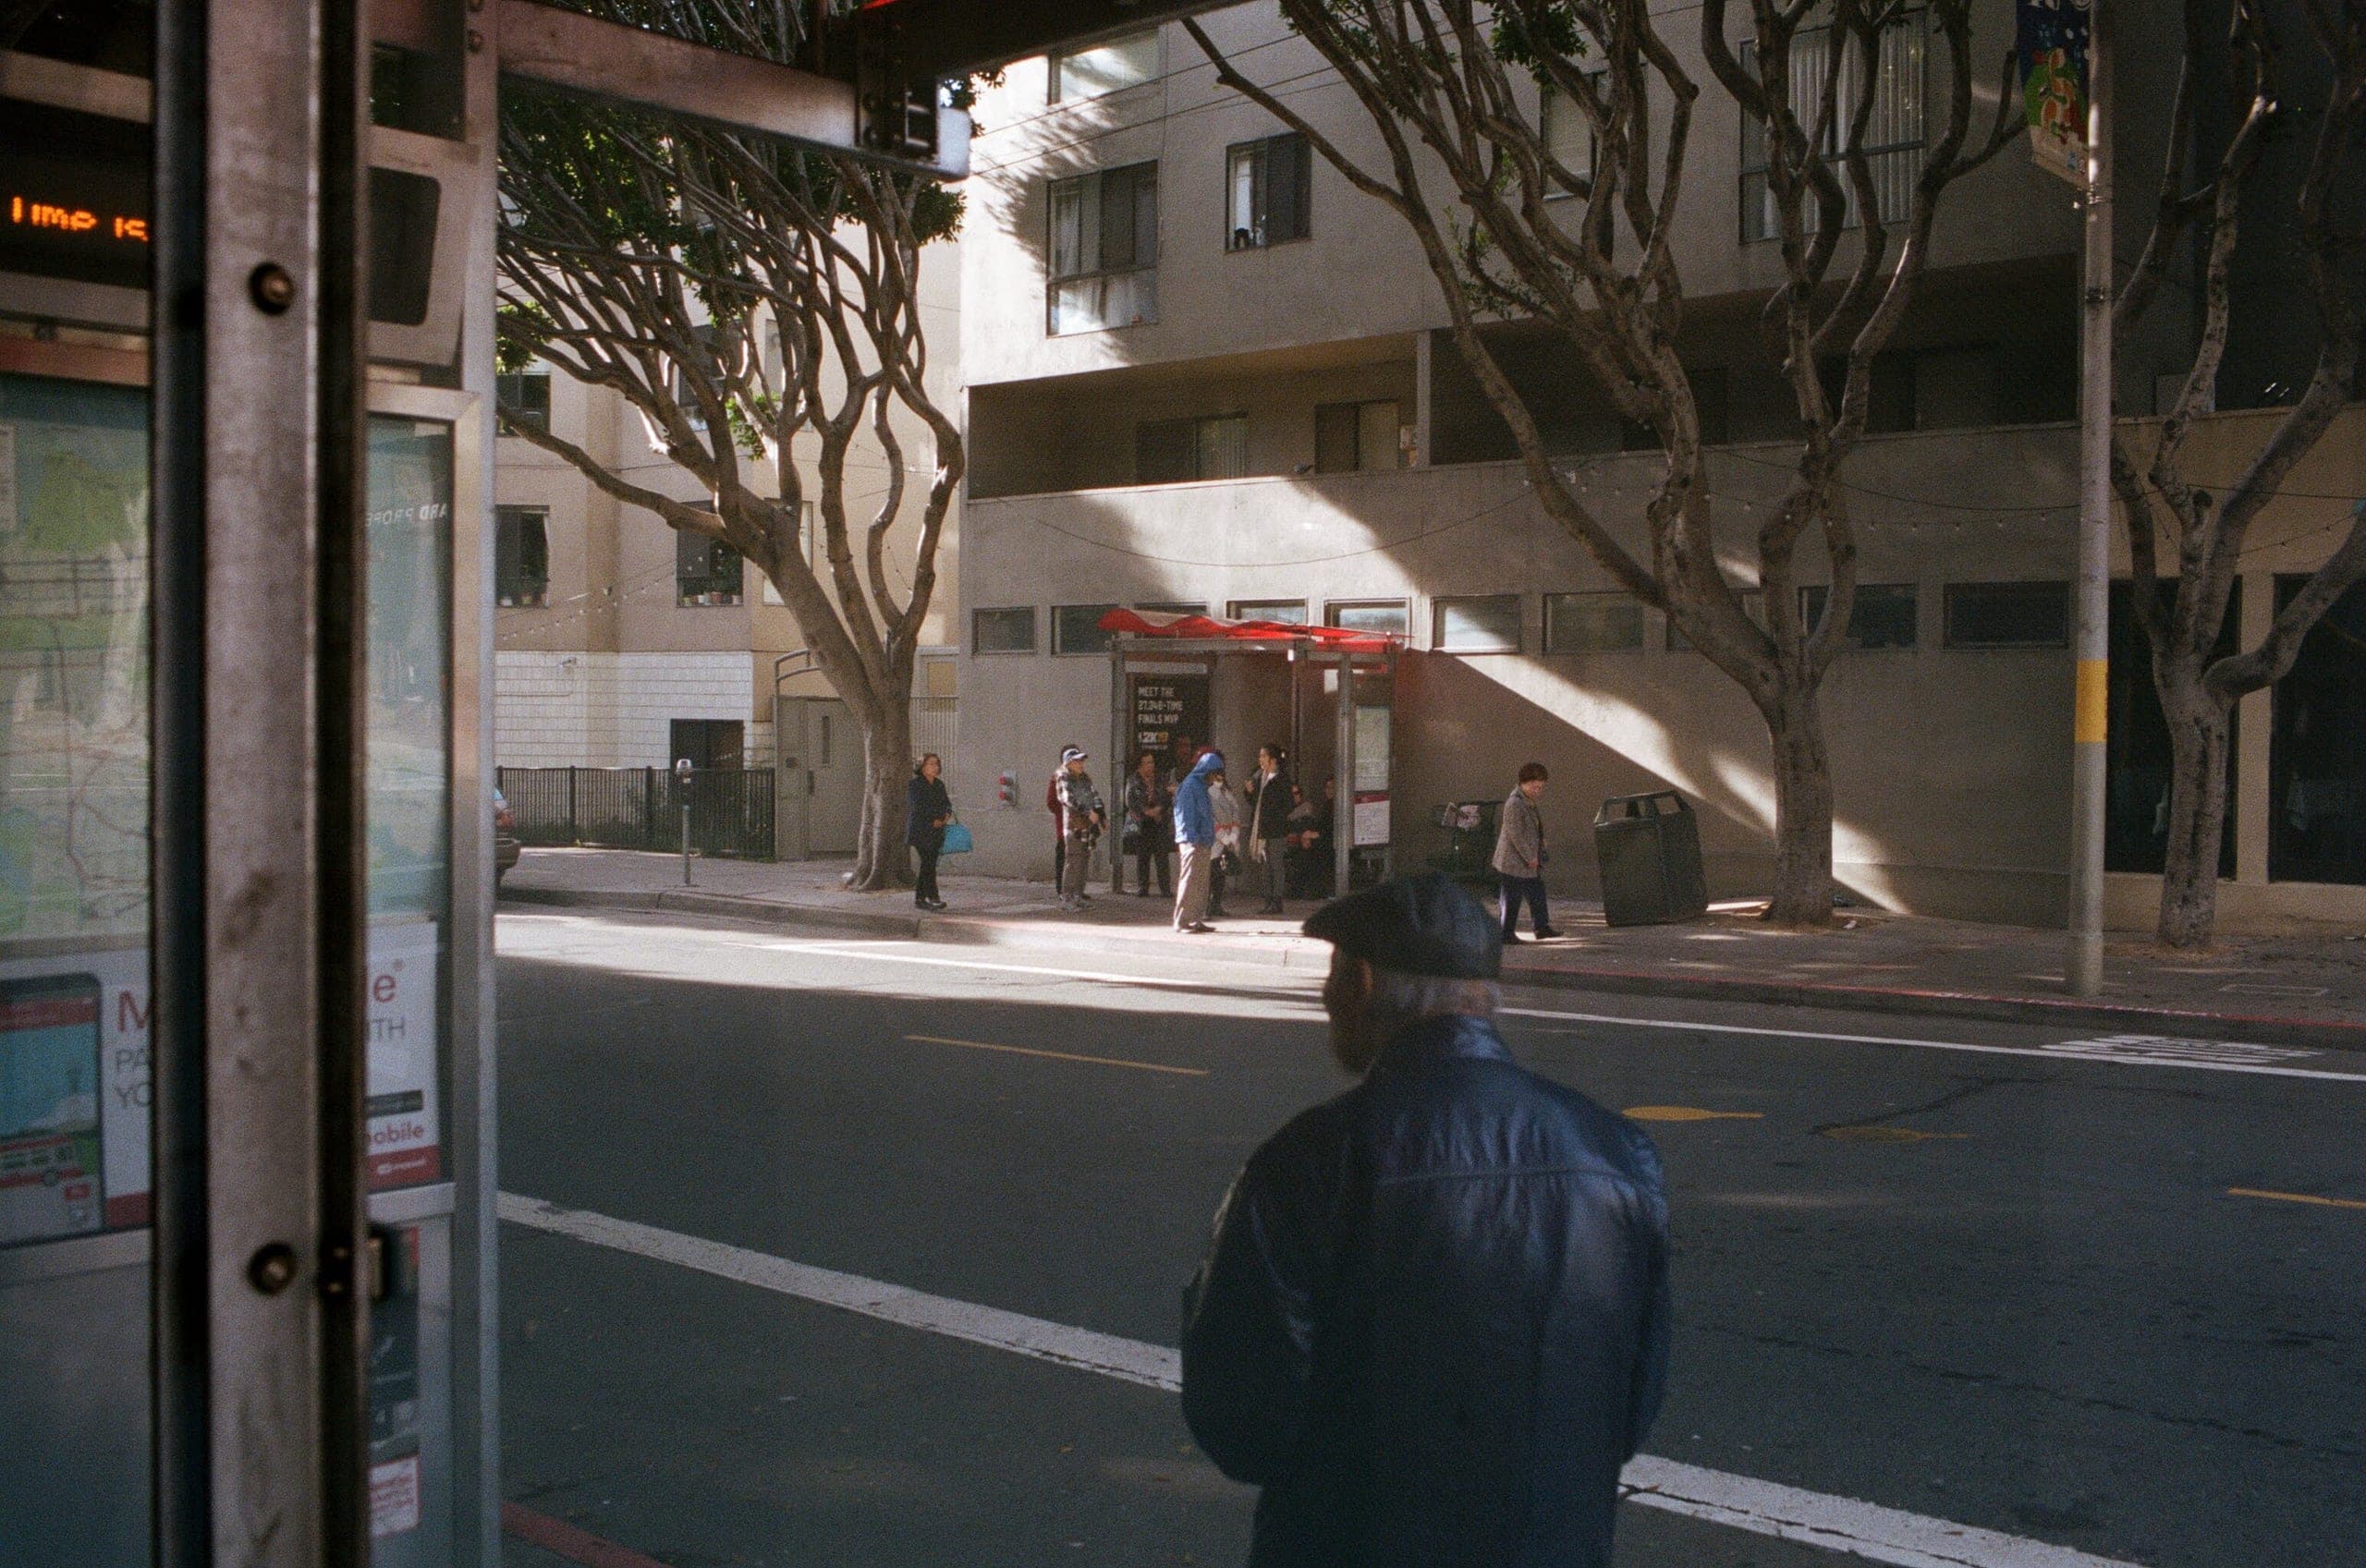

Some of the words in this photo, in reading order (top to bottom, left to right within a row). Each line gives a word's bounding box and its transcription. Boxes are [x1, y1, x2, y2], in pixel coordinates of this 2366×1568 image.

[1138, 687, 1159, 697] MEET
[1161, 687, 1175, 697] THE
[1138, 713, 1162, 723] FINALS
[1165, 713, 1178, 723] MVP
